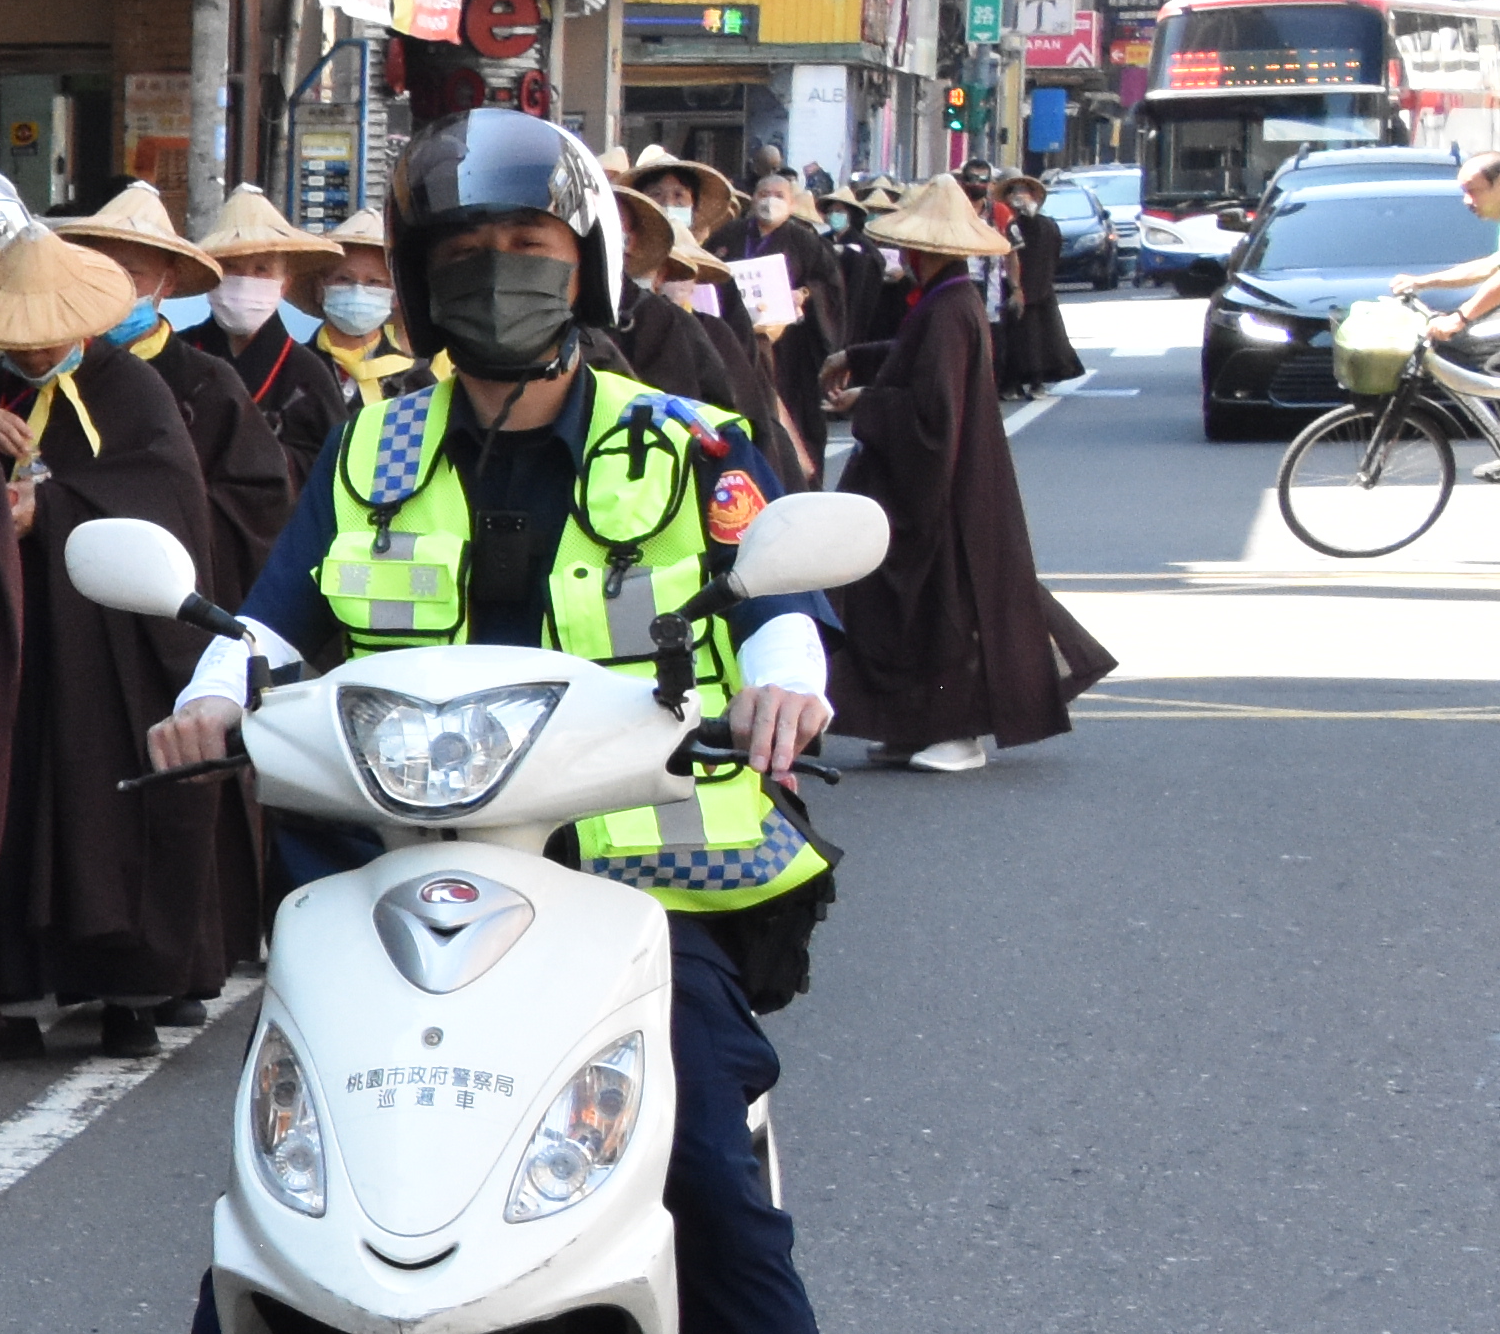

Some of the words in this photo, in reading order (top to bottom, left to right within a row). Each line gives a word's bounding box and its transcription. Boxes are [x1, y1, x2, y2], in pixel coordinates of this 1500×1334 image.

[345, 1065, 515, 1098] 桃園市政府警察局
